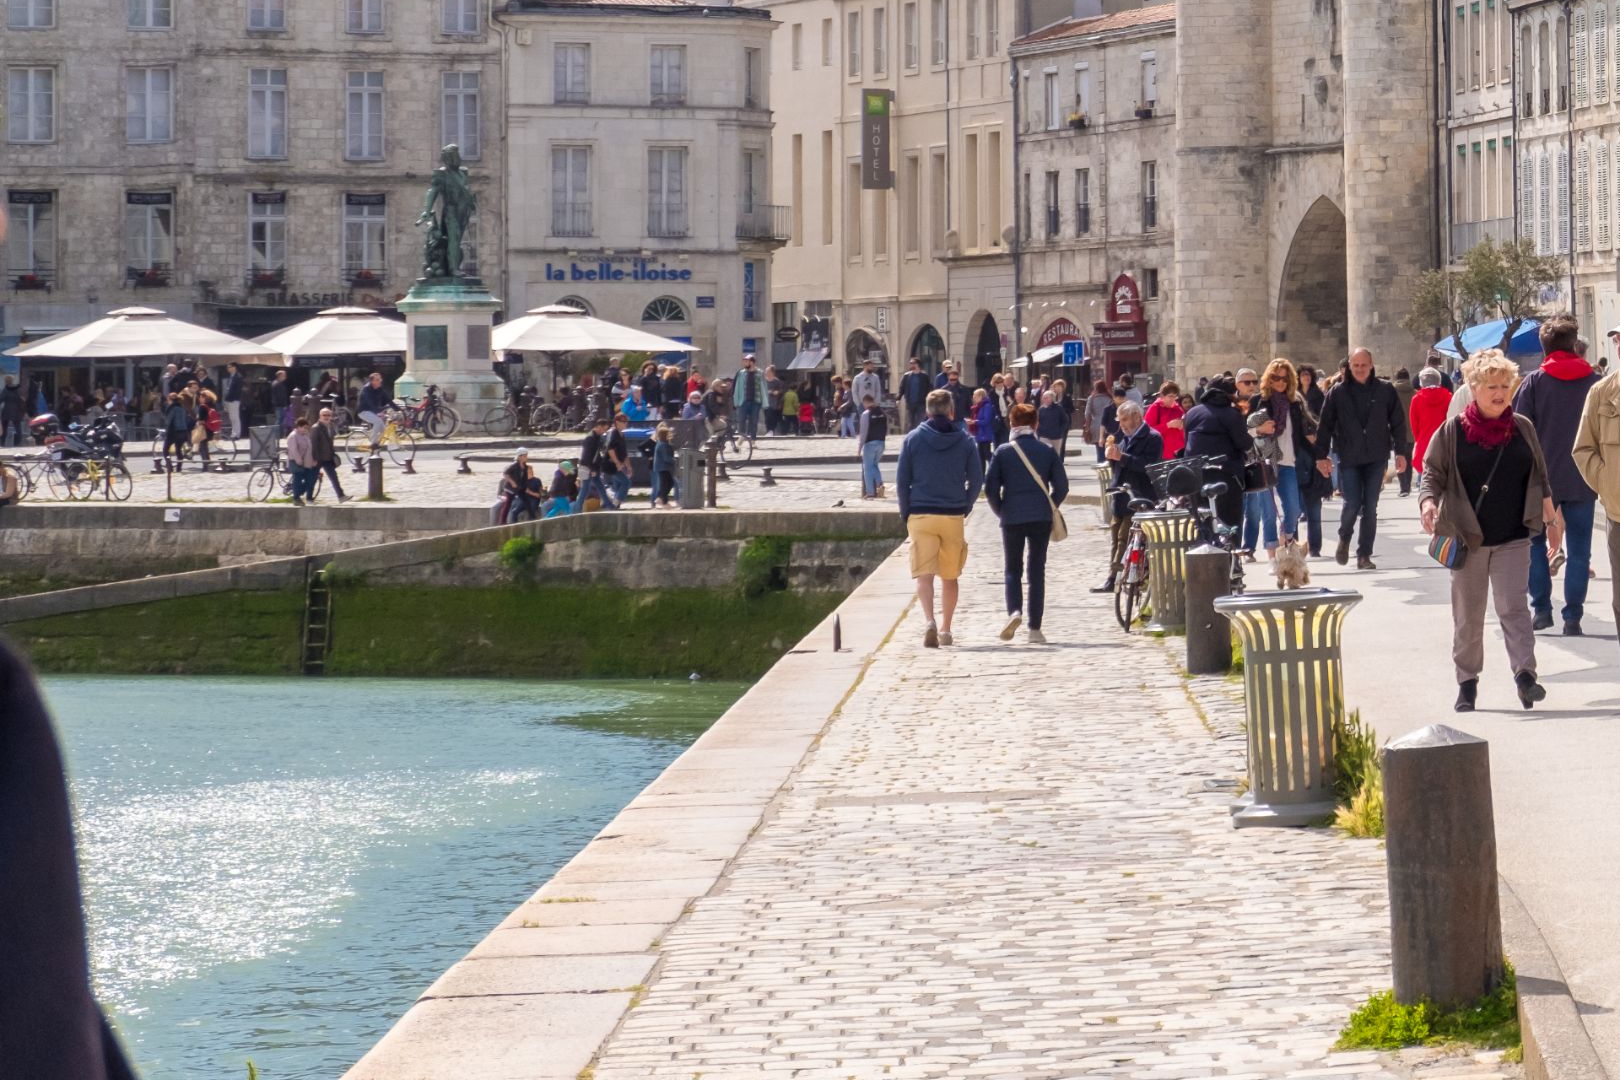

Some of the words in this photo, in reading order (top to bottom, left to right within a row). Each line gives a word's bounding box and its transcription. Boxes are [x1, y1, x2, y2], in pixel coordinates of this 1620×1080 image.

[872, 124, 881, 181] HOTEL
[546, 263, 565, 281] la
[267, 292, 355, 306] BRASSERIE
